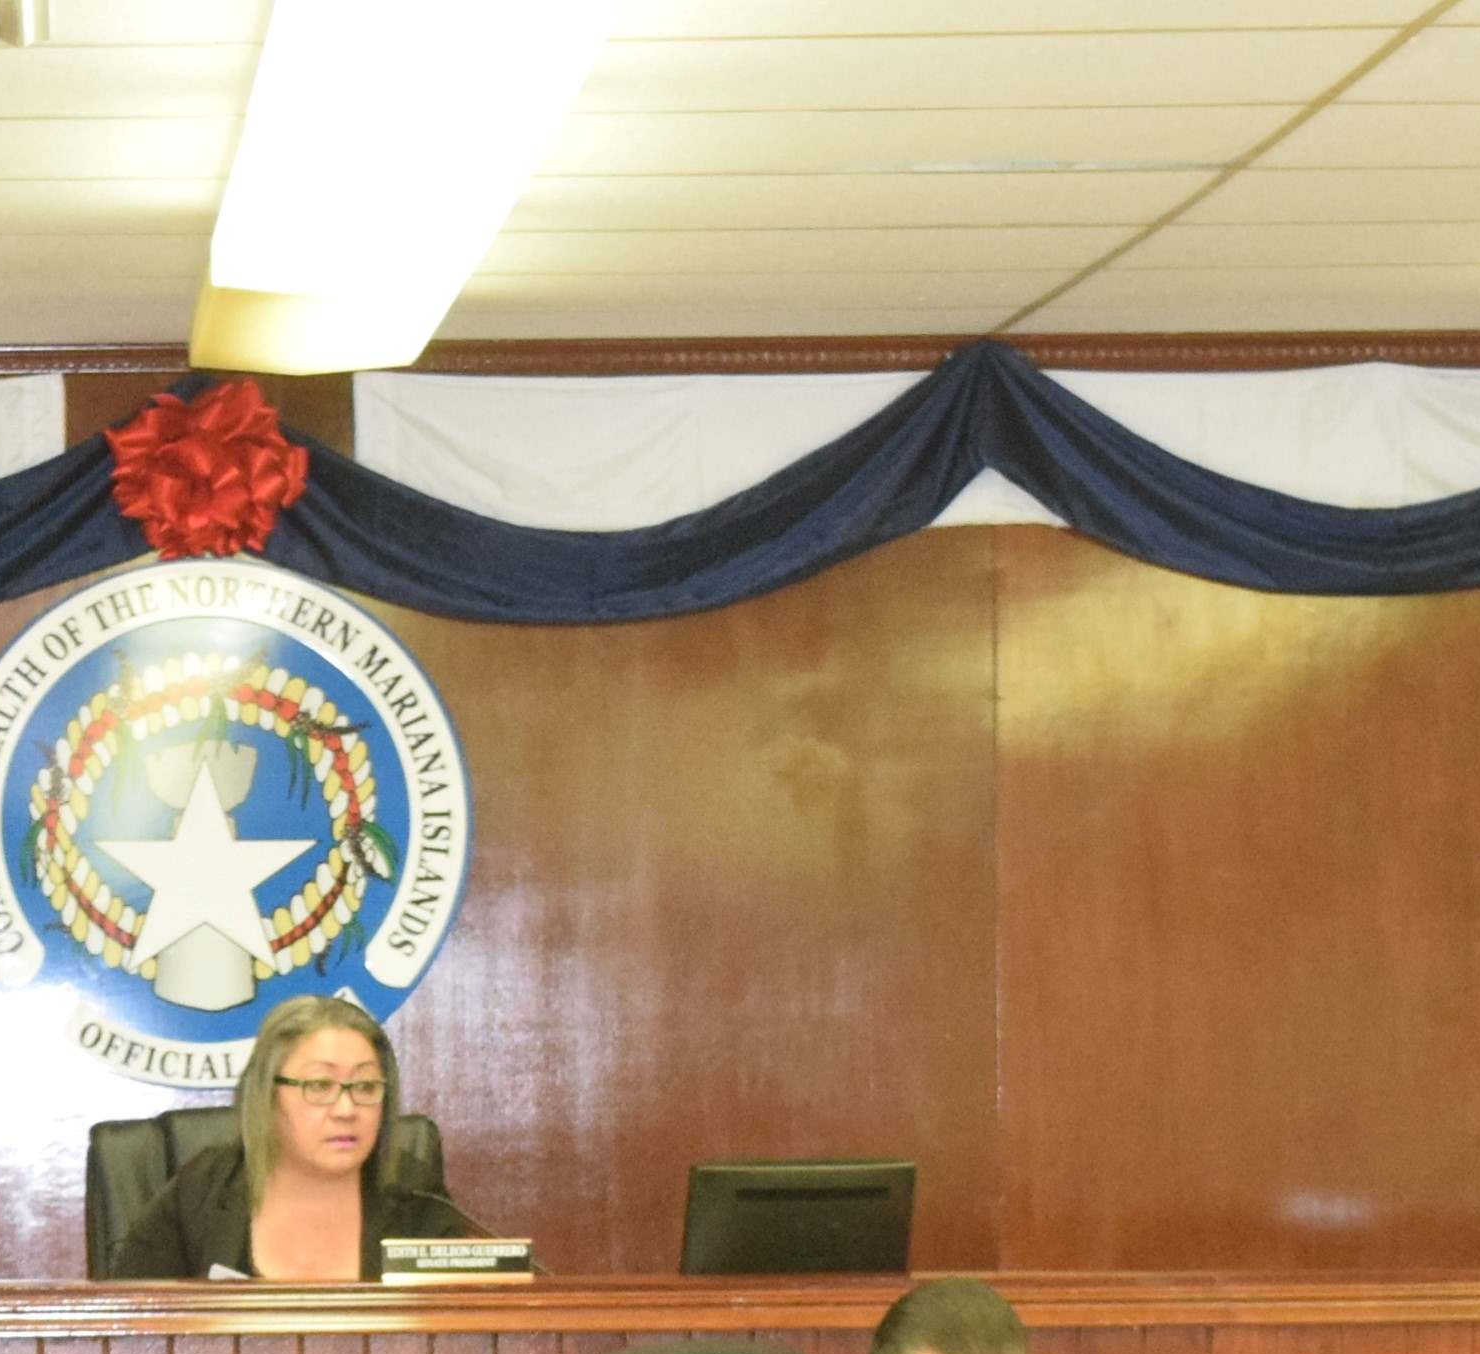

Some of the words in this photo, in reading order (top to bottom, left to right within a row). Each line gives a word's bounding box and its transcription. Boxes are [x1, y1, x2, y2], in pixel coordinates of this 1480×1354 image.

[42, 621, 84, 662] OF
[85, 583, 159, 632] THE
[166, 574, 360, 652] NORTHERN
[353, 646, 451, 799] MARIANA
[386, 807, 454, 959] ISLANDS
[78, 1020, 240, 1081] OFFICIAL
